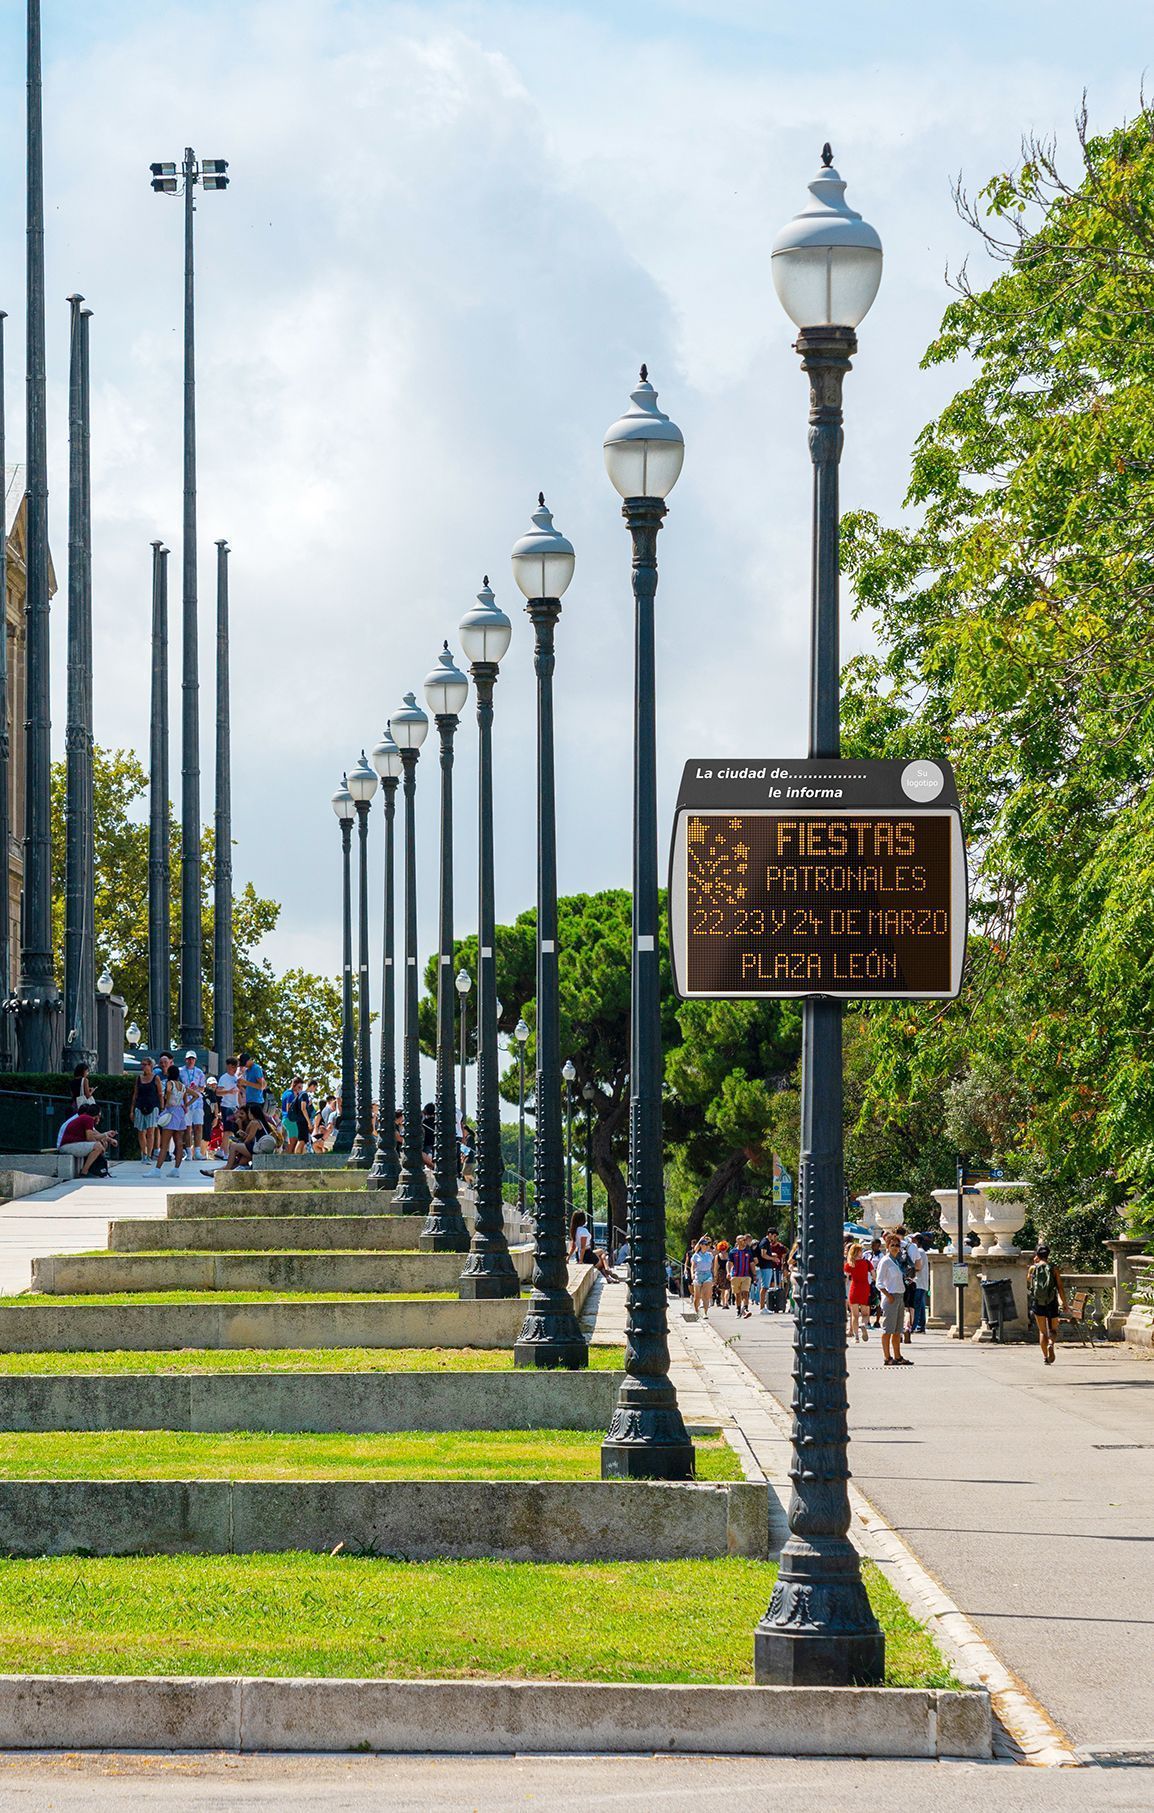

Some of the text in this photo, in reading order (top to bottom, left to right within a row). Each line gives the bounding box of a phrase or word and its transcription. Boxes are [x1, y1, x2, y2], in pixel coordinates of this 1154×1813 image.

[696, 767, 713, 779] La
[717, 767, 765, 779] ciudad
[916, 769, 928, 777] Su
[768, 787, 843, 798] le informa
[906, 779, 939, 788] logotipo
[777, 822, 916, 856] FIESTAS
[766, 866, 927, 891] PATRONALES
[793, 909, 823, 935] 24
[830, 909, 861, 935] DE
[868, 909, 948, 935] MARZO
[742, 948, 897, 979] PLAZA LEÓN
